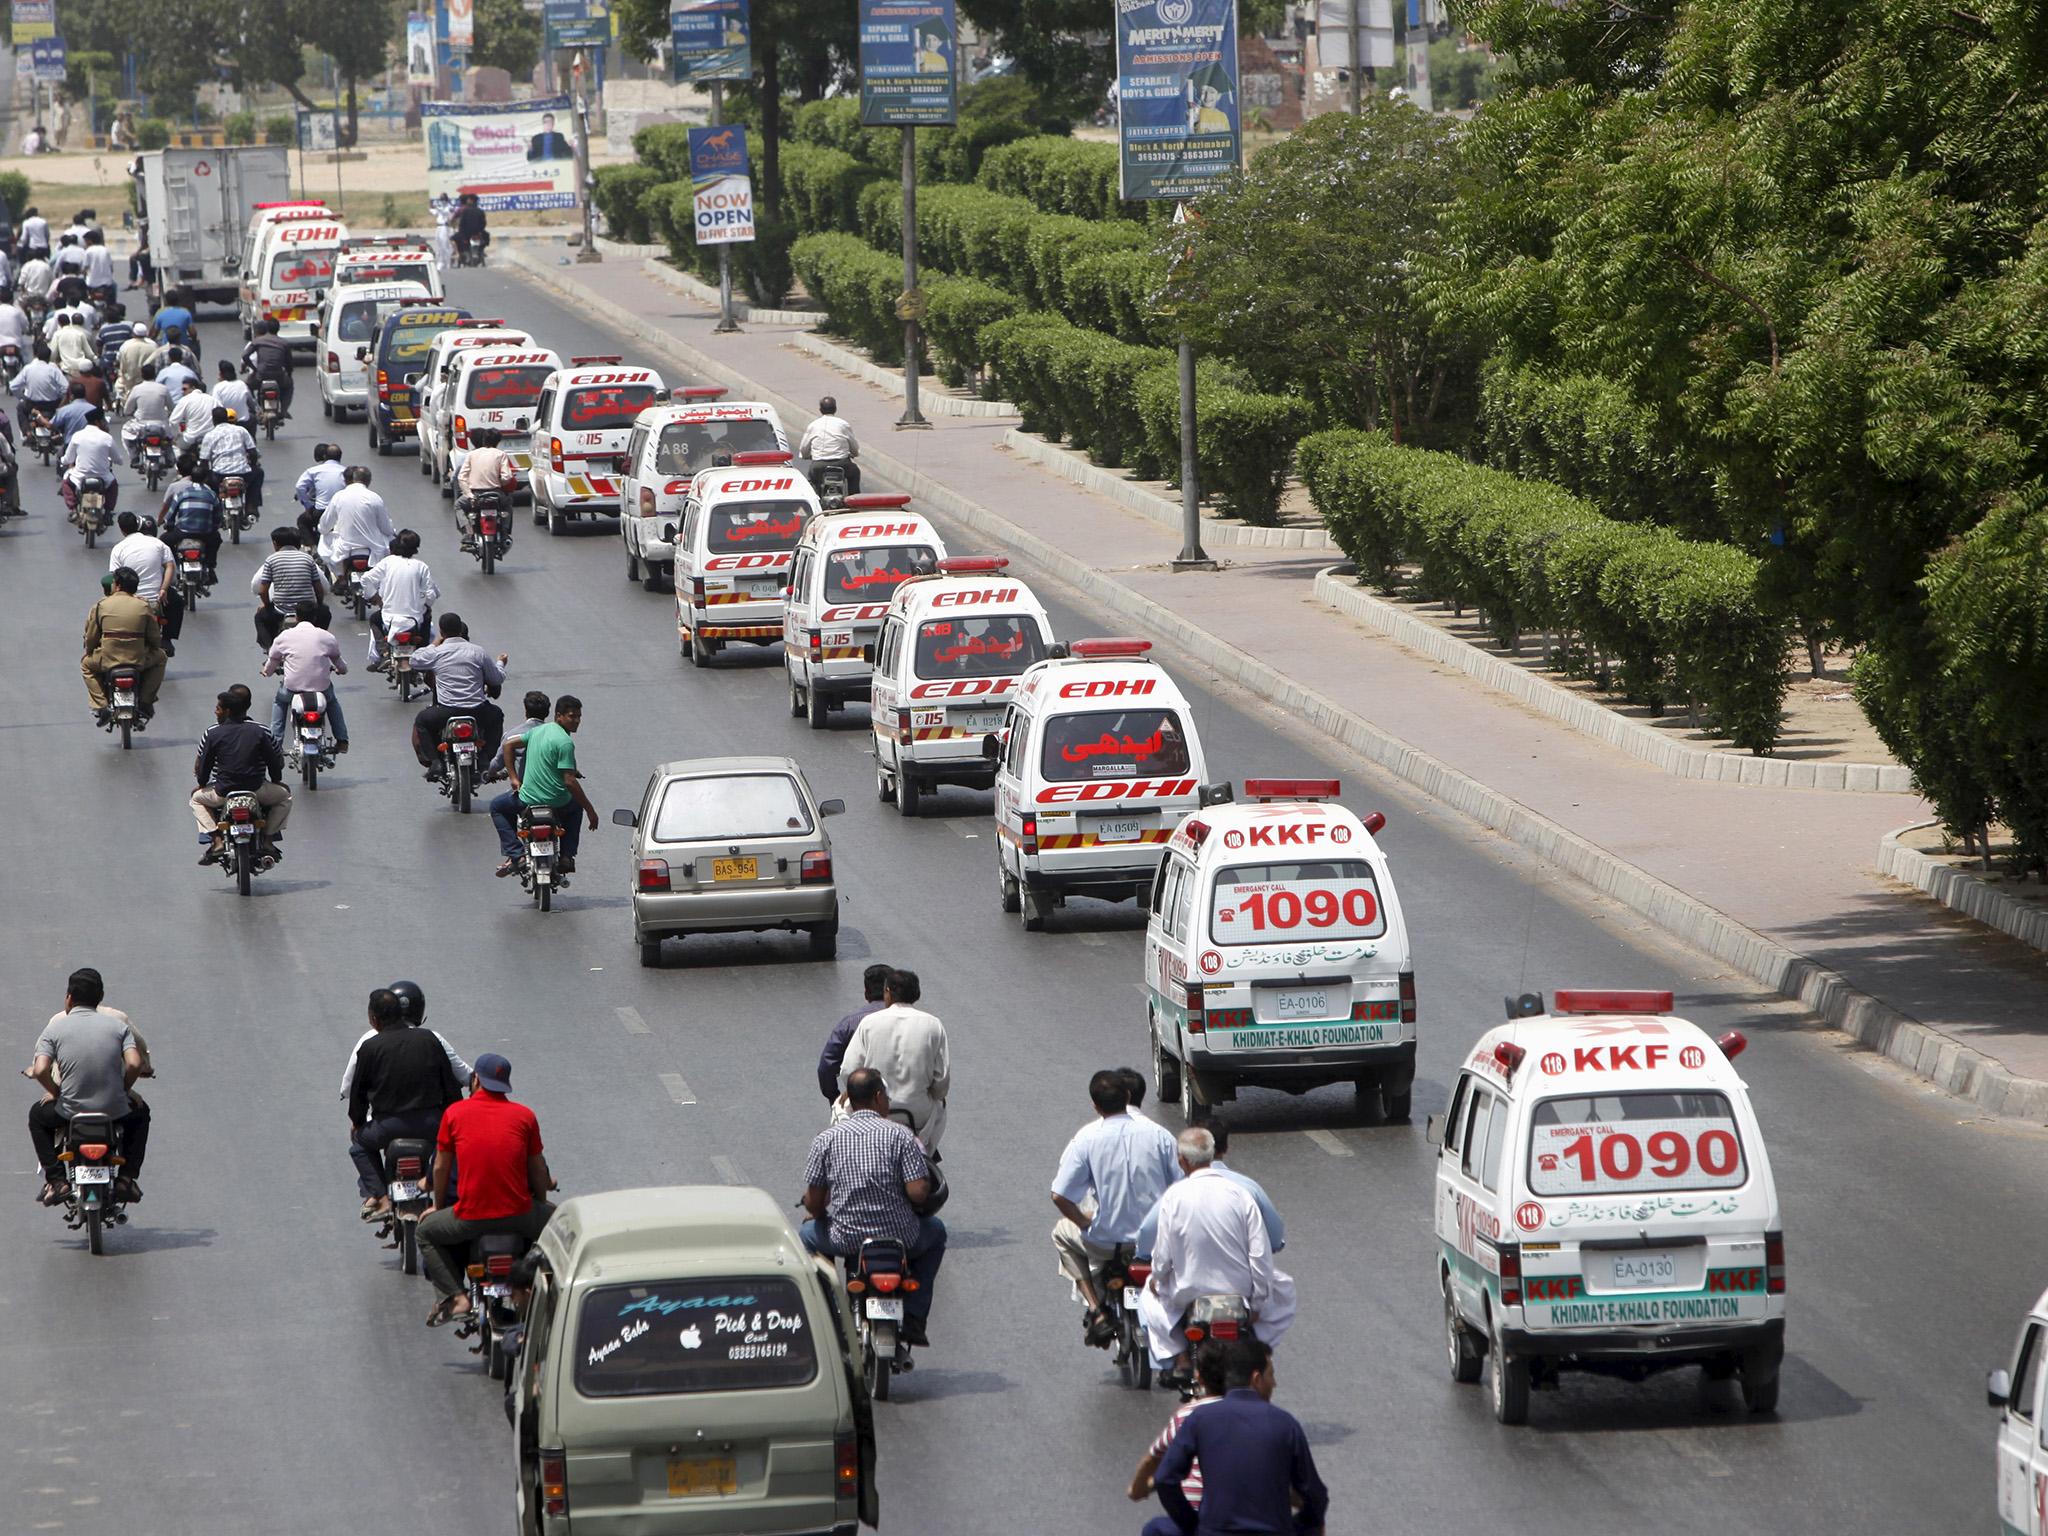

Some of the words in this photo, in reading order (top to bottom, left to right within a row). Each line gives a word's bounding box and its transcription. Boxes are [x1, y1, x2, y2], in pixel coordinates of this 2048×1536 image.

[1132, 53, 1193, 65] ADMISSIONS
[1194, 51, 1222, 61] OPEN
[1129, 76, 1172, 86] SEPARATE
[1121, 89, 1145, 98] BOYS
[1154, 87, 1180, 97] GIRLS
[697, 193, 749, 210] NOW
[698, 209, 752, 227] OPEN
[281, 227, 339, 242] EDHI
[287, 293, 309, 304] 115
[400, 313, 459, 325] EDHI
[473, 353, 549, 367] EDHI
[570, 372, 650, 385] EDHI
[487, 411, 504, 423] 115
[586, 433, 603, 445] 115
[721, 478, 794, 493] EDHI
[838, 523, 918, 539] EDHI
[931, 588, 1019, 608] EDHI
[833, 634, 850, 646] 115
[1059, 679, 1157, 699] EDHI
[924, 713, 944, 726] 115
[1035, 779, 1198, 804] EDHI
[1100, 824, 1113, 836] EA
[1227, 832, 1244, 849] 108
[1249, 823, 1327, 847] KKF
[1334, 828, 1350, 844] 108
[1233, 884, 1269, 894] EMERGANCY
[1271, 883, 1286, 892] CALL
[1239, 888, 1377, 931] 1090
[1280, 995, 1326, 1010] EA-0106
[1208, 1010, 1250, 1029] KKF
[1354, 1003, 1398, 1021] KKF
[1233, 1029, 1321, 1049] KHIDMAT-E-KHALQ
[1322, 1025, 1384, 1046] FOUNDATION
[1544, 1053, 1563, 1074] 118
[1573, 1044, 1669, 1073] KKF
[1682, 1048, 1701, 1068] 118
[1550, 1126, 1595, 1138] EMERGANCY
[1597, 1124, 1615, 1135] CALL
[1563, 1129, 1739, 1183] 1090
[1521, 1206, 1539, 1225] 118
[1615, 1261, 1674, 1279] EA-0130
[1526, 1277, 1583, 1301] KKF
[1708, 1269, 1763, 1293] KKF
[617, 1295, 759, 1317] Ayaan
[1551, 1302, 1659, 1325] KHIDMAT-E-KHALQ
[1662, 1297, 1739, 1319] FOUNDATION
[714, 1311, 746, 1335] Pick
[751, 1310, 762, 1331] &
[767, 1309, 803, 1335] Drop
